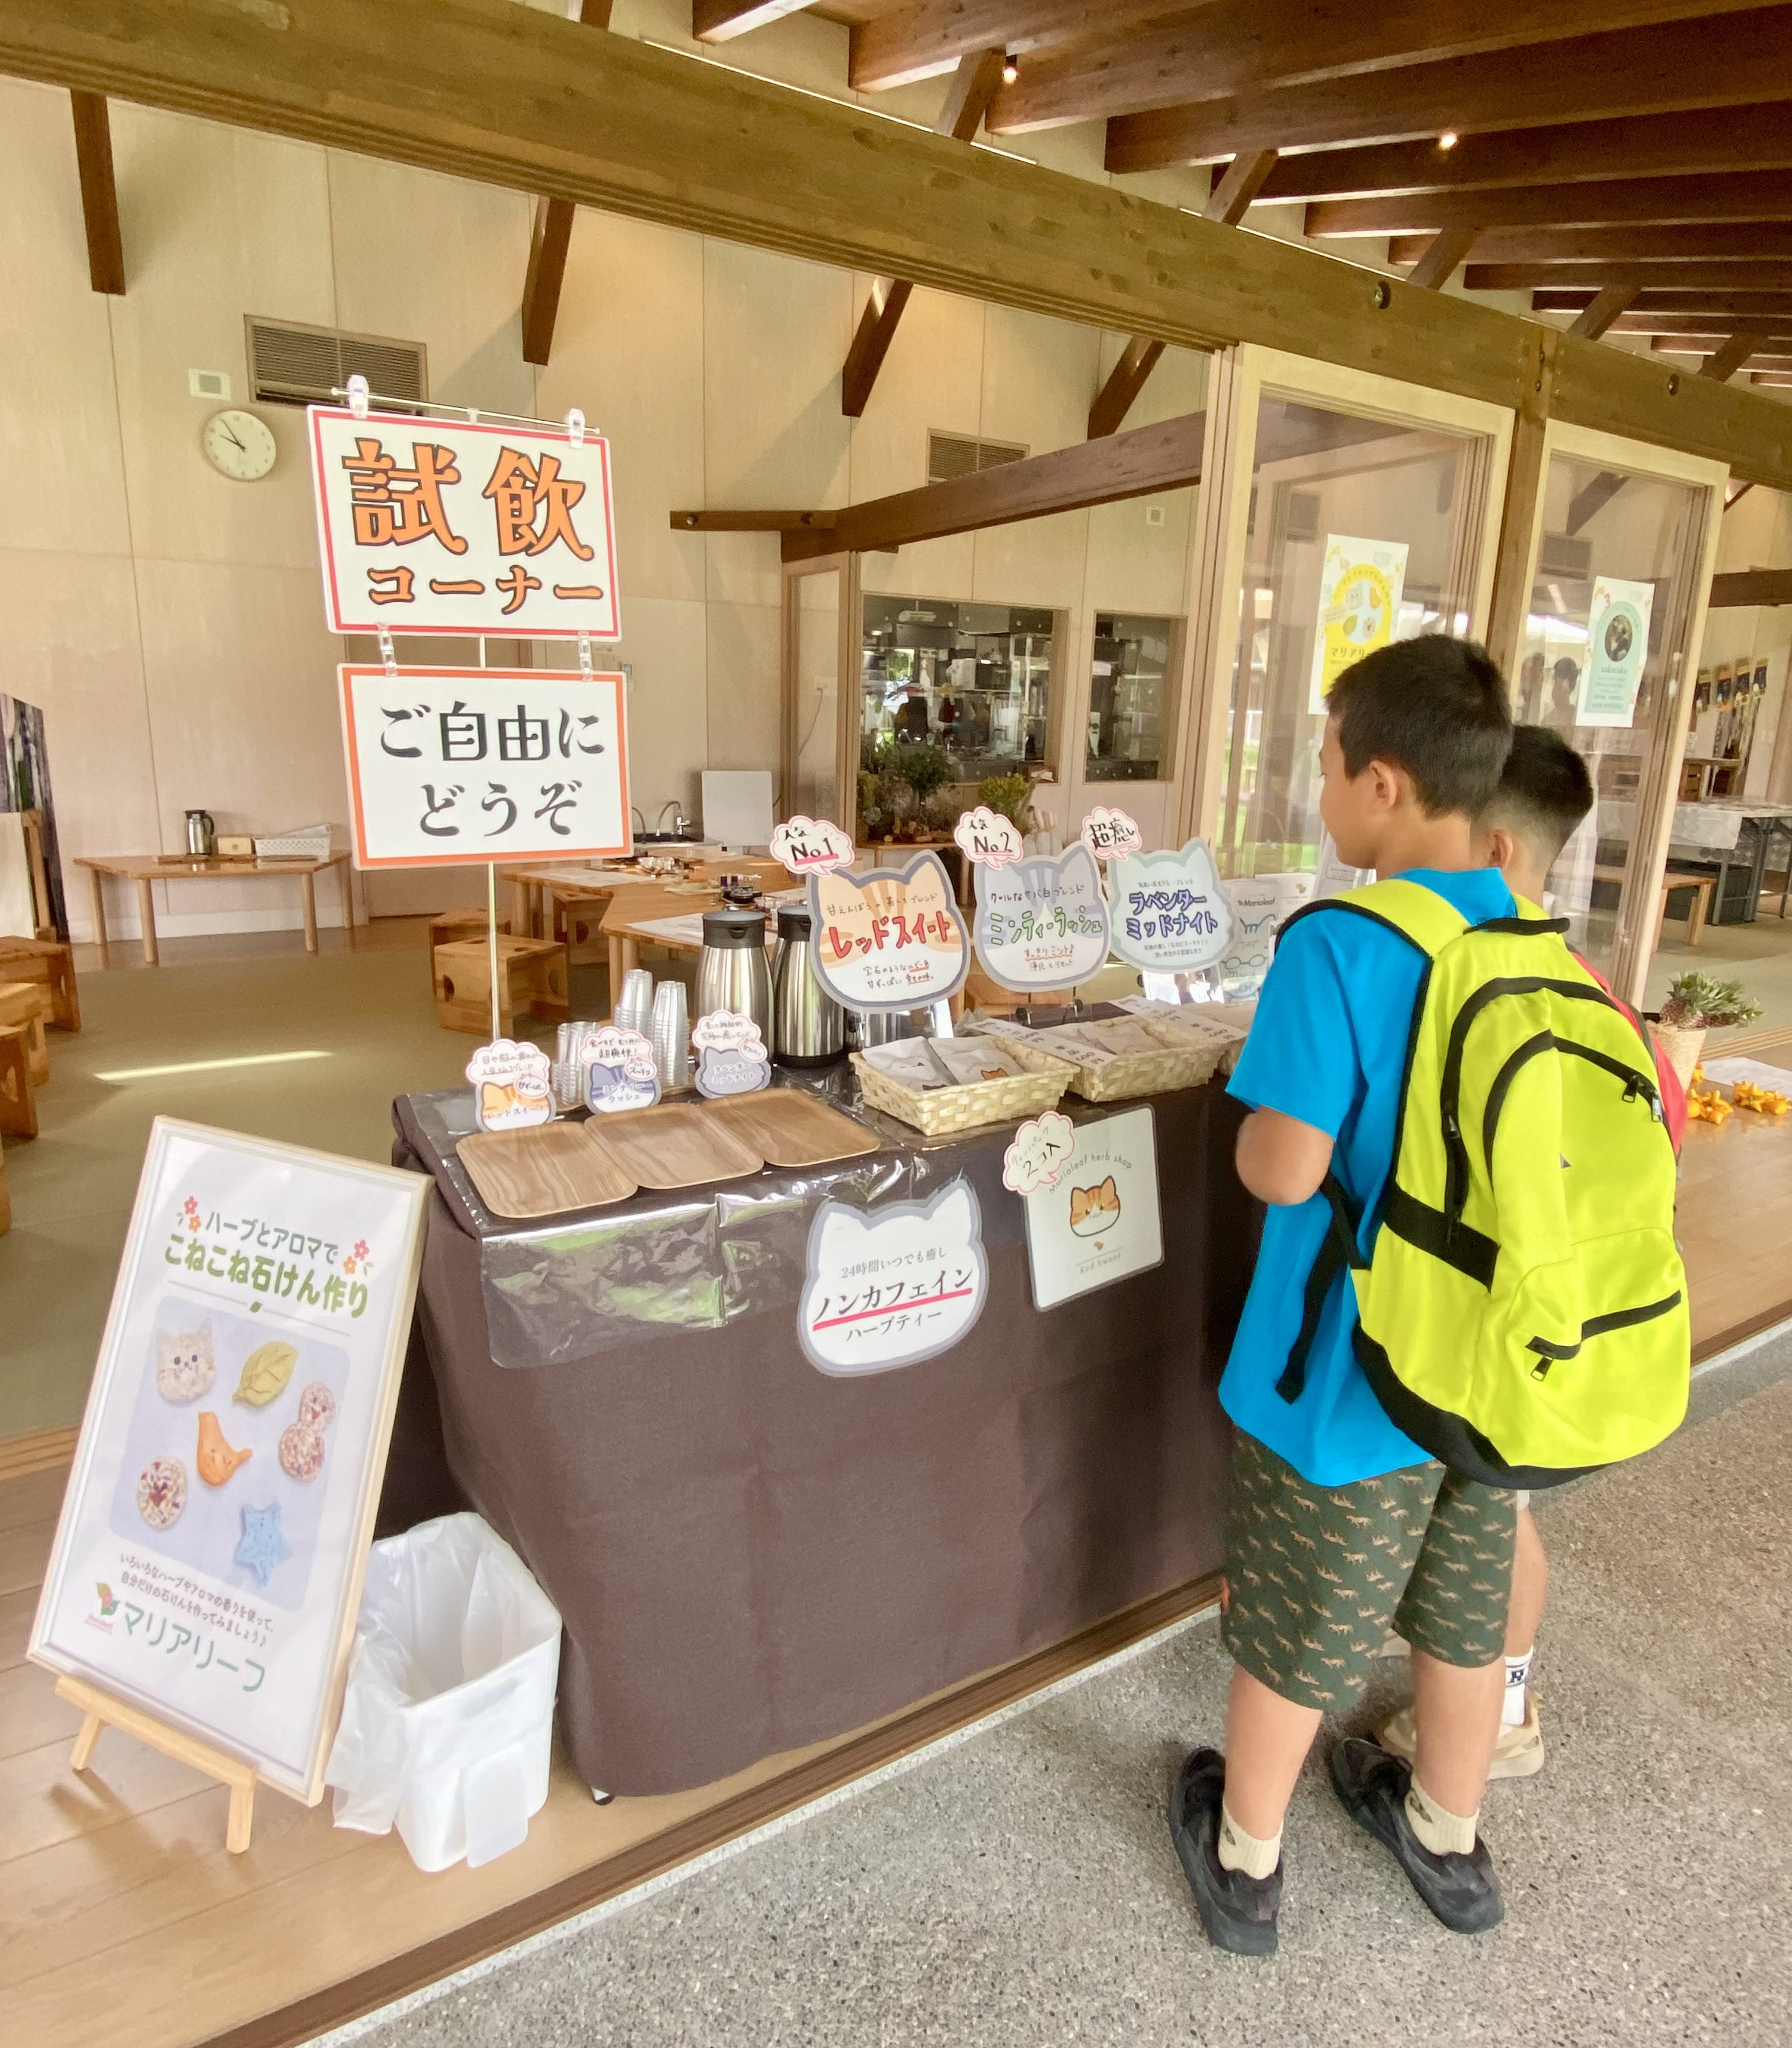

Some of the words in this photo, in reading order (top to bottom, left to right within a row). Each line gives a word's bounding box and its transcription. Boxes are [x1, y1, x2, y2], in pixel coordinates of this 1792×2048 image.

[342, 437, 596, 561] 試飲
[367, 564, 604, 615] コーナー
[380, 700, 605, 761] ご自由に
[419, 779, 582, 837] どうぞ
[1089, 817, 1135, 850] 超癒し
[1126, 911, 1218, 940] ミッドナイト
[1129, 888, 1207, 916] ラベンダー
[829, 911, 950, 959] レッドスイート
[487, 1104, 545, 1119] レッドスイート
[608, 1093, 641, 1103] ラッシュ
[1049, 1156, 1087, 1195] Marialeaf
[1091, 1152, 1110, 1162] herb
[1113, 1155, 1132, 1170] shop
[205, 1211, 338, 1265] ハーブとアロマで
[165, 1233, 368, 1319] こねこね石けん作り
[841, 1246, 947, 1279] 24時間いつでも癒し
[812, 1268, 974, 1323] ノンカフェイン
[845, 1310, 942, 1342] ハーブティー
[124, 1601, 265, 1692] マリアリーフ
